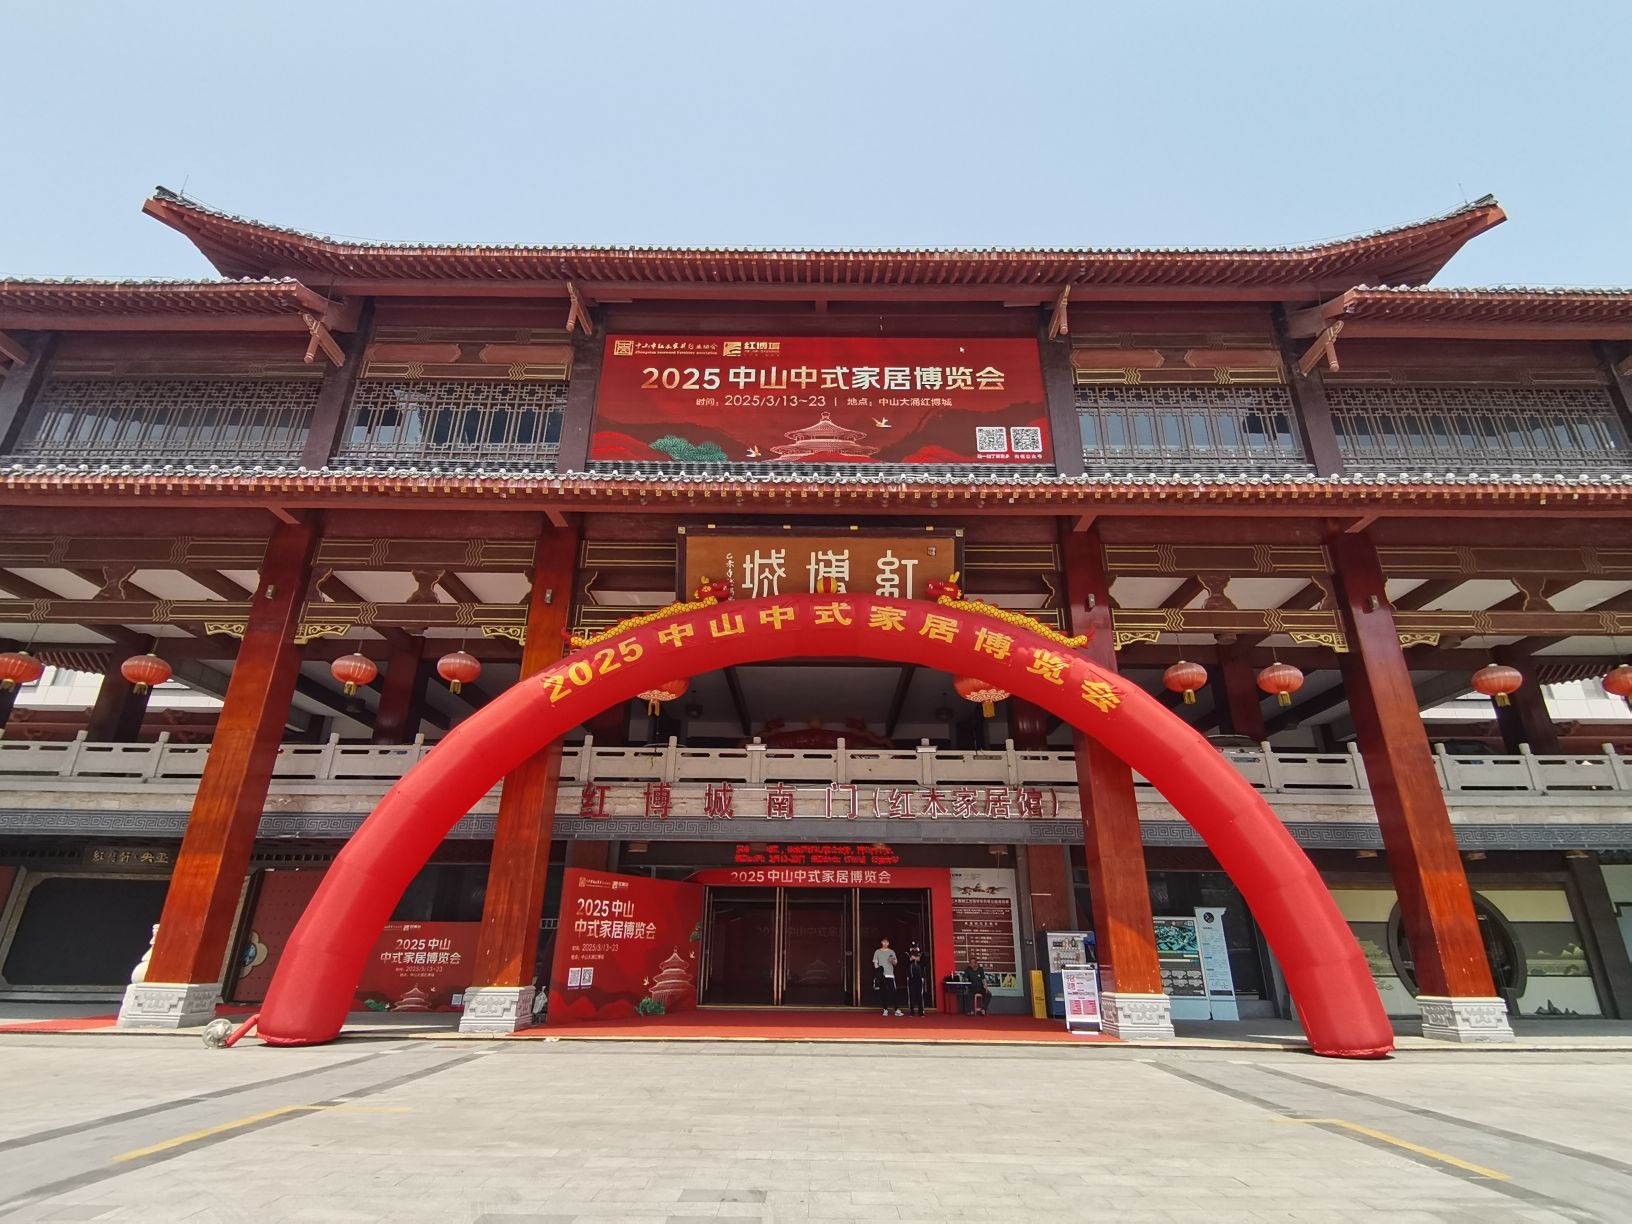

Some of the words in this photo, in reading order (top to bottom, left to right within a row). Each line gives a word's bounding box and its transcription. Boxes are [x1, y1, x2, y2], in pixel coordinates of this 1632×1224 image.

[641, 365, 1006, 392] 2025中山中式家居博览会
[878, 397, 953, 407] 中山大涌红博城
[730, 869, 891, 884] 2025中山中式家居博览会
[574, 919, 657, 940] 中式家居博览会
[380, 952, 461, 964] 中式家居博览会
